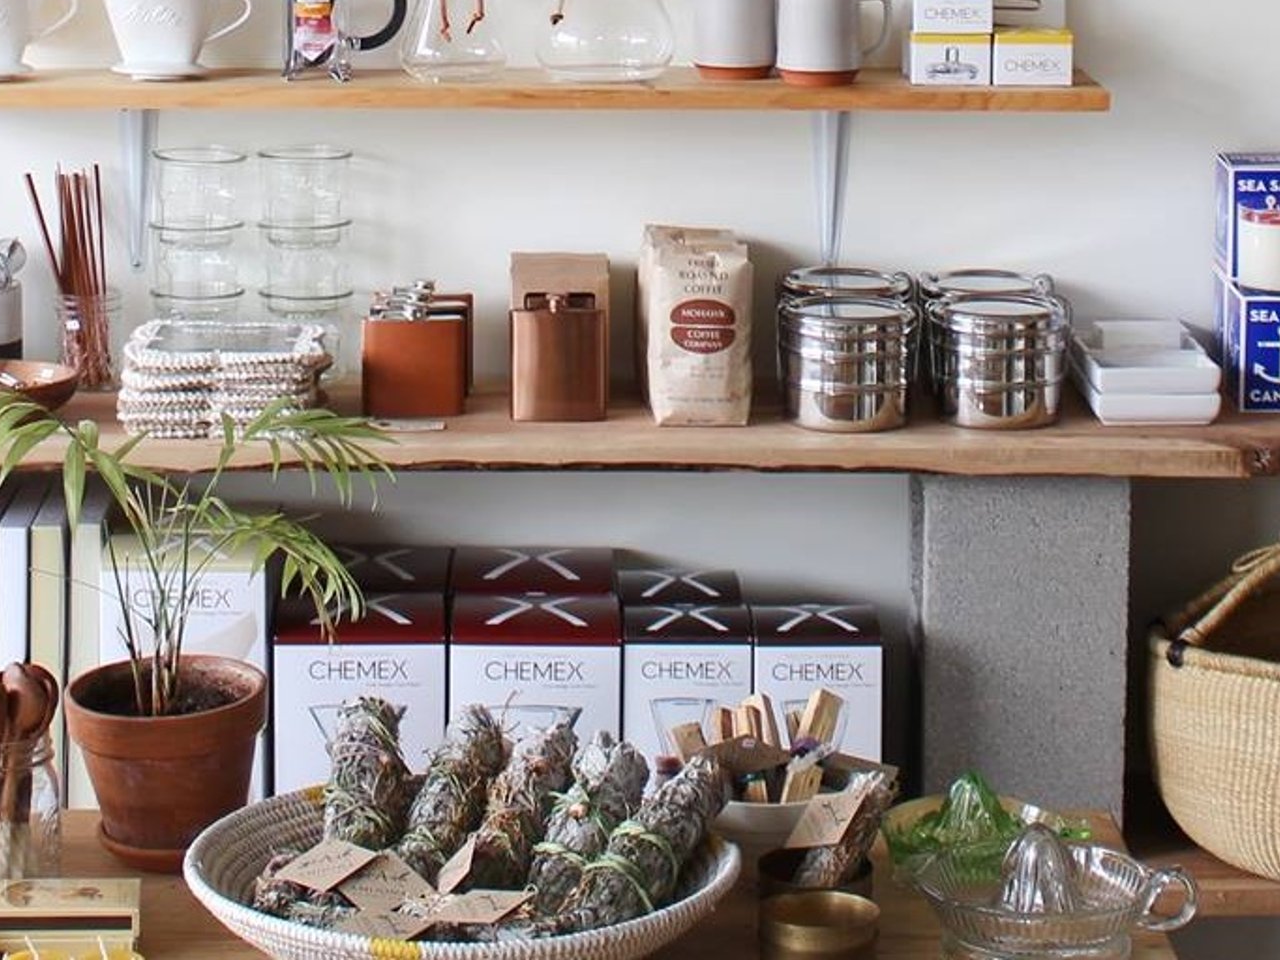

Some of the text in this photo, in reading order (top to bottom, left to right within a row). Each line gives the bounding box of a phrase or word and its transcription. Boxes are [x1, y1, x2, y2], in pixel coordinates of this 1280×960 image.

[924, 7, 984, 21] CHEMEX
[1003, 59, 1062, 73] CHEMEX
[1237, 178, 1265, 192] SEA
[1250, 309, 1279, 322] SEA
[686, 329, 721, 339] COFFEE
[133, 589, 231, 608] CHEMEX
[309, 659, 408, 680] CHEMEX
[485, 660, 584, 681] CHEMEX
[641, 660, 732, 680] CHEMEX
[772, 662, 863, 682] CHEMEX
